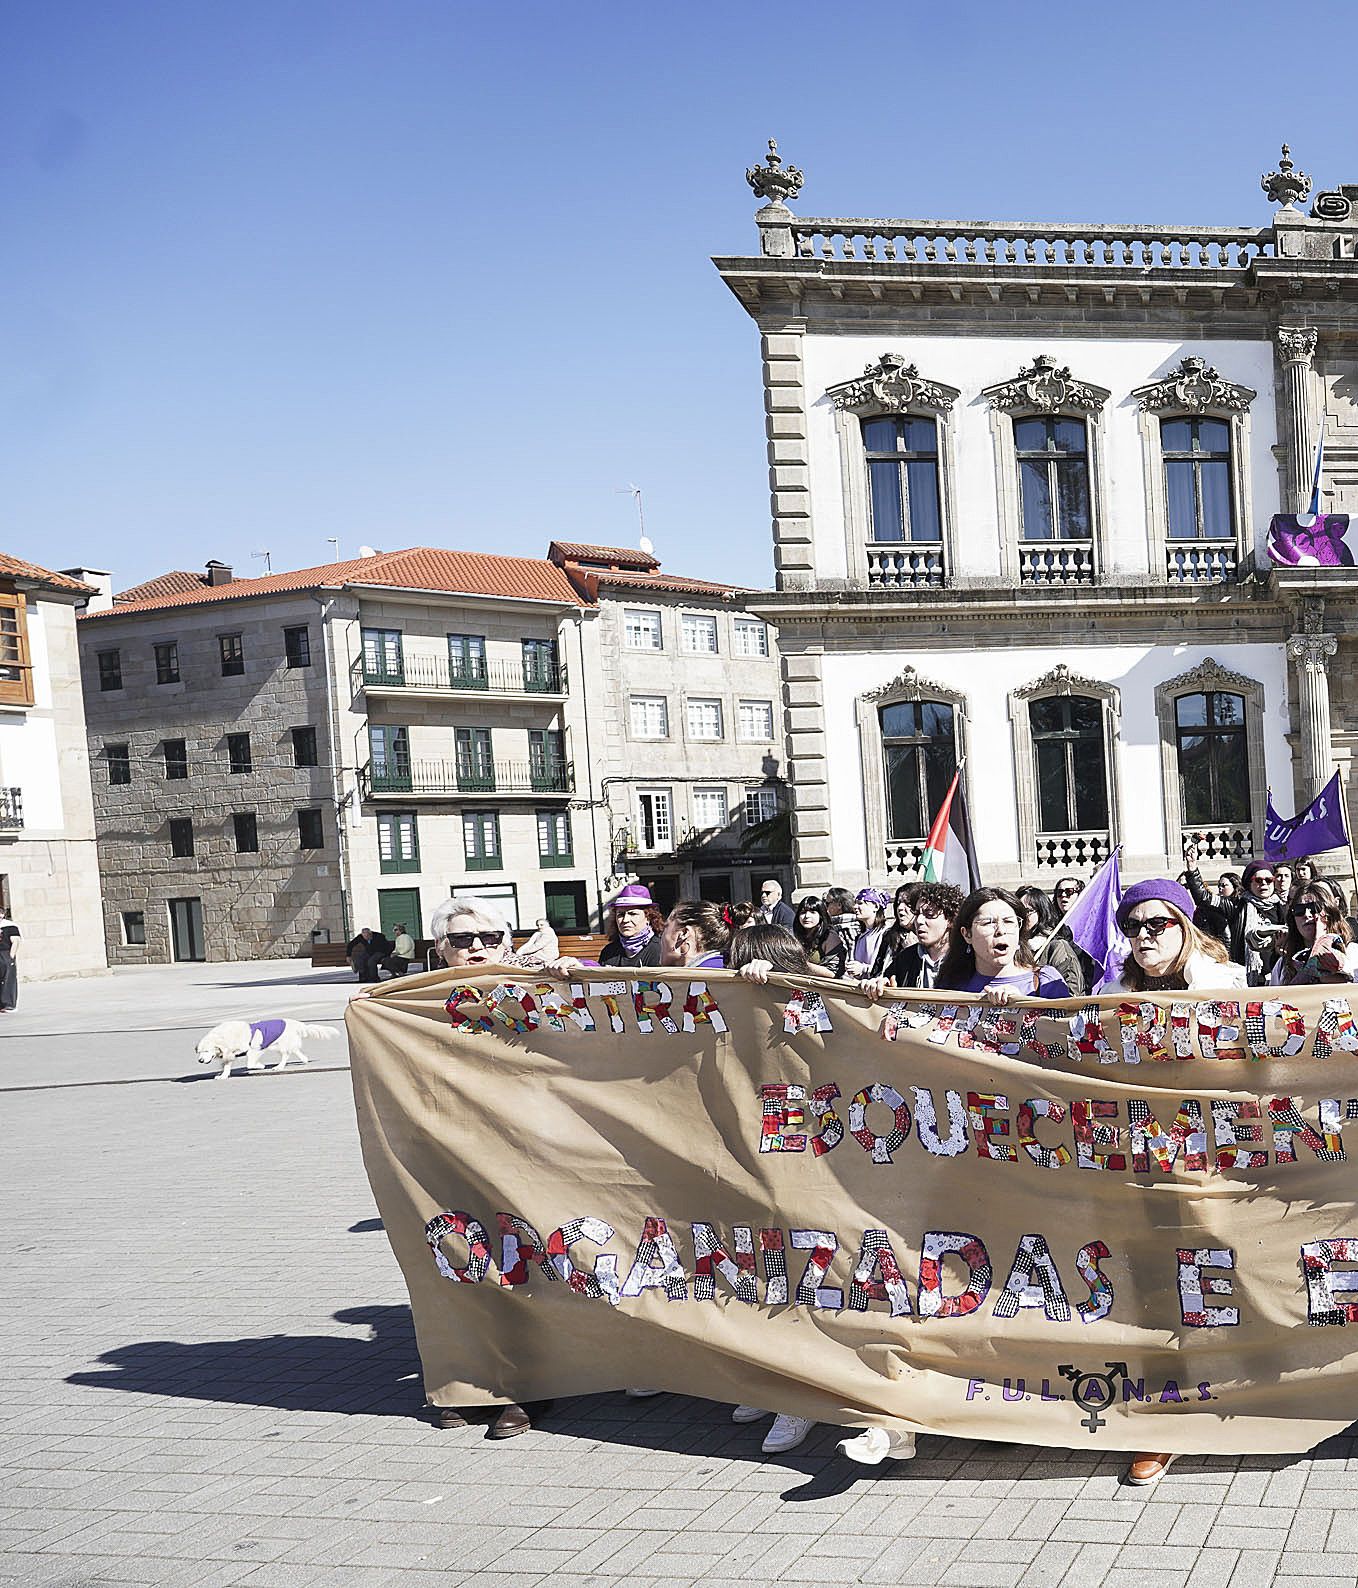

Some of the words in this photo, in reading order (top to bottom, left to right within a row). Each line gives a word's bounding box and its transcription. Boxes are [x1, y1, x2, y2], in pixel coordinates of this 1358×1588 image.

[443, 981, 728, 1036] CONTRA
[782, 989, 834, 1034] A
[424, 1210, 1113, 1323] ORGANIZADAS
[1176, 1247, 1240, 1328] E
